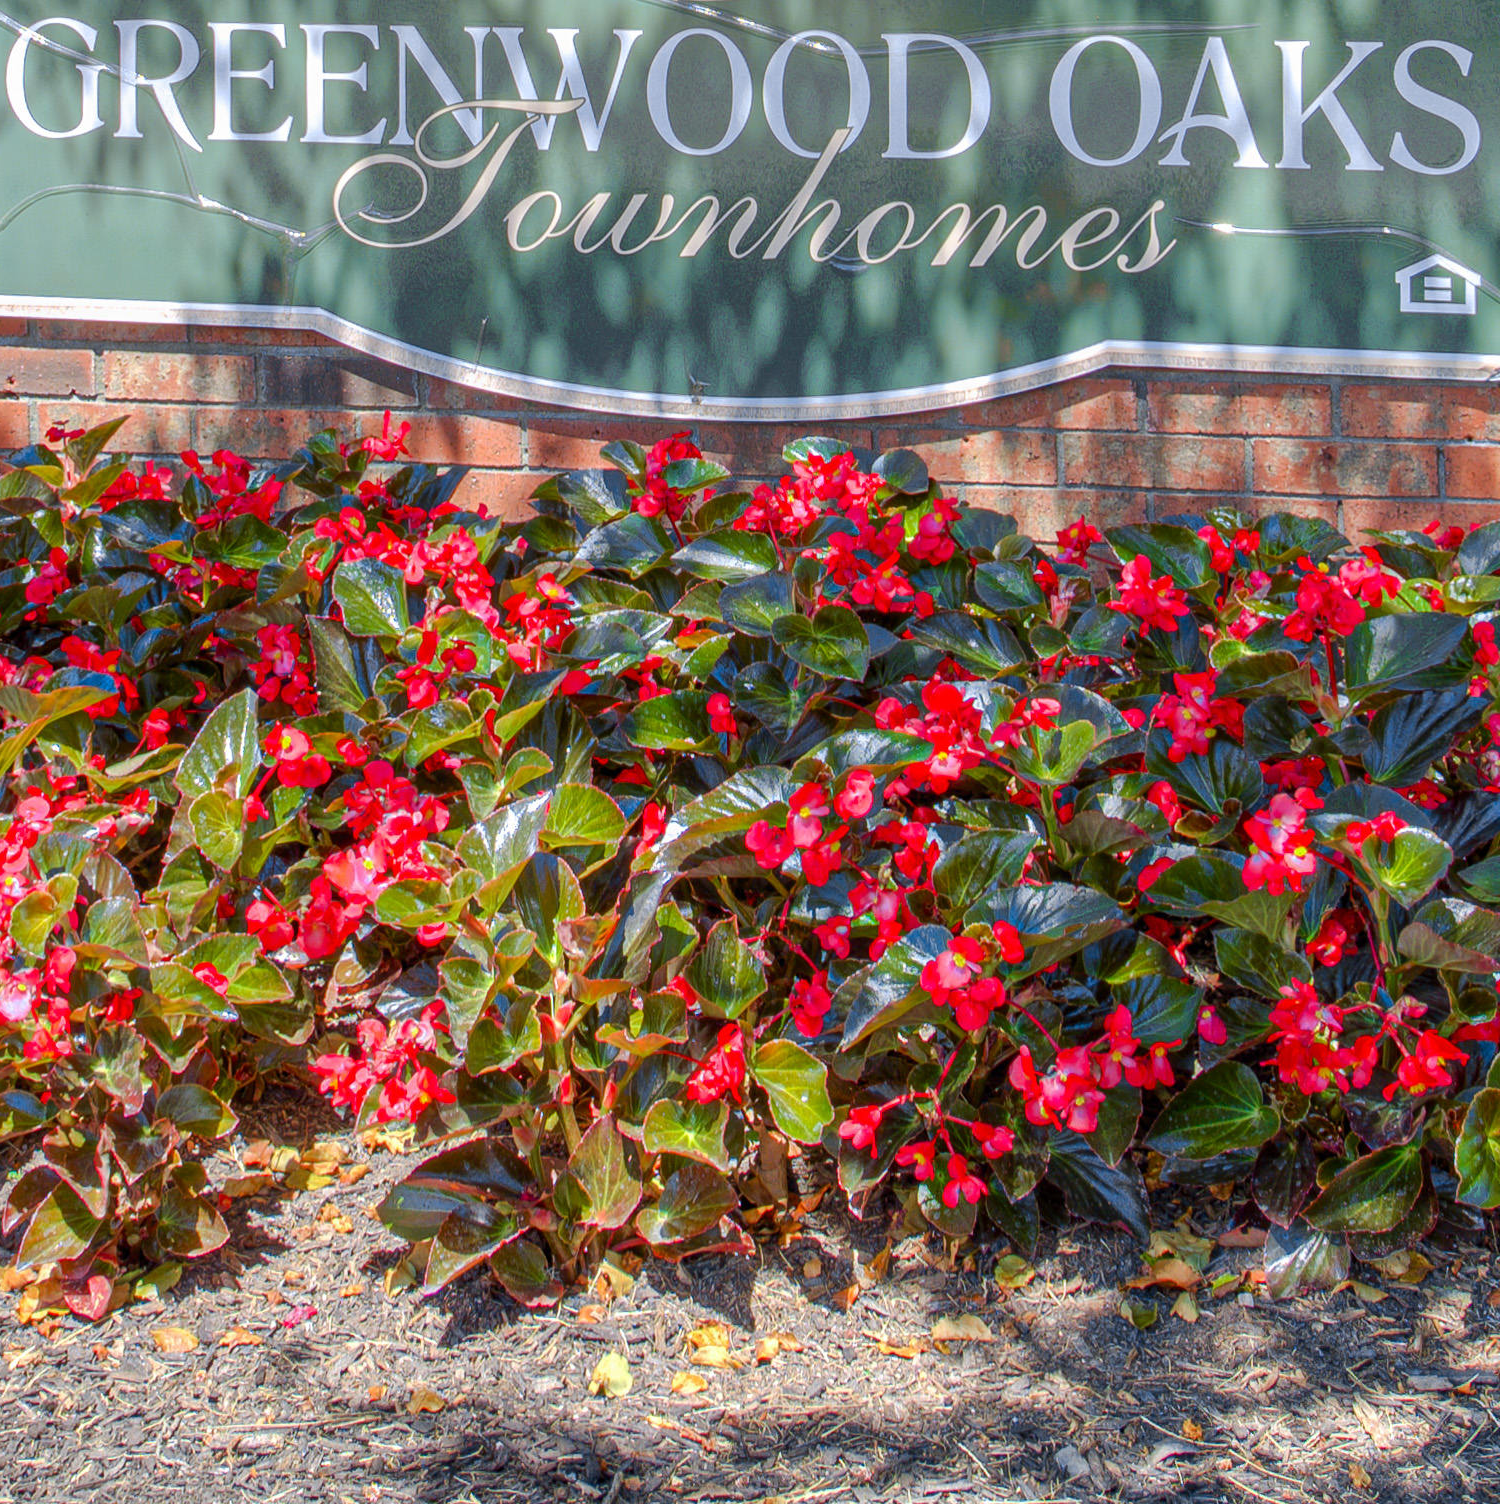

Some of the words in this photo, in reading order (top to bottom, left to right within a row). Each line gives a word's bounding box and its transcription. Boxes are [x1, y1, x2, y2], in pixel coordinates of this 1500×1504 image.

[5, 16, 992, 160] GREENWOOD
[1048, 34, 1482, 176] OAKS
[333, 97, 1178, 273] Townhomes
